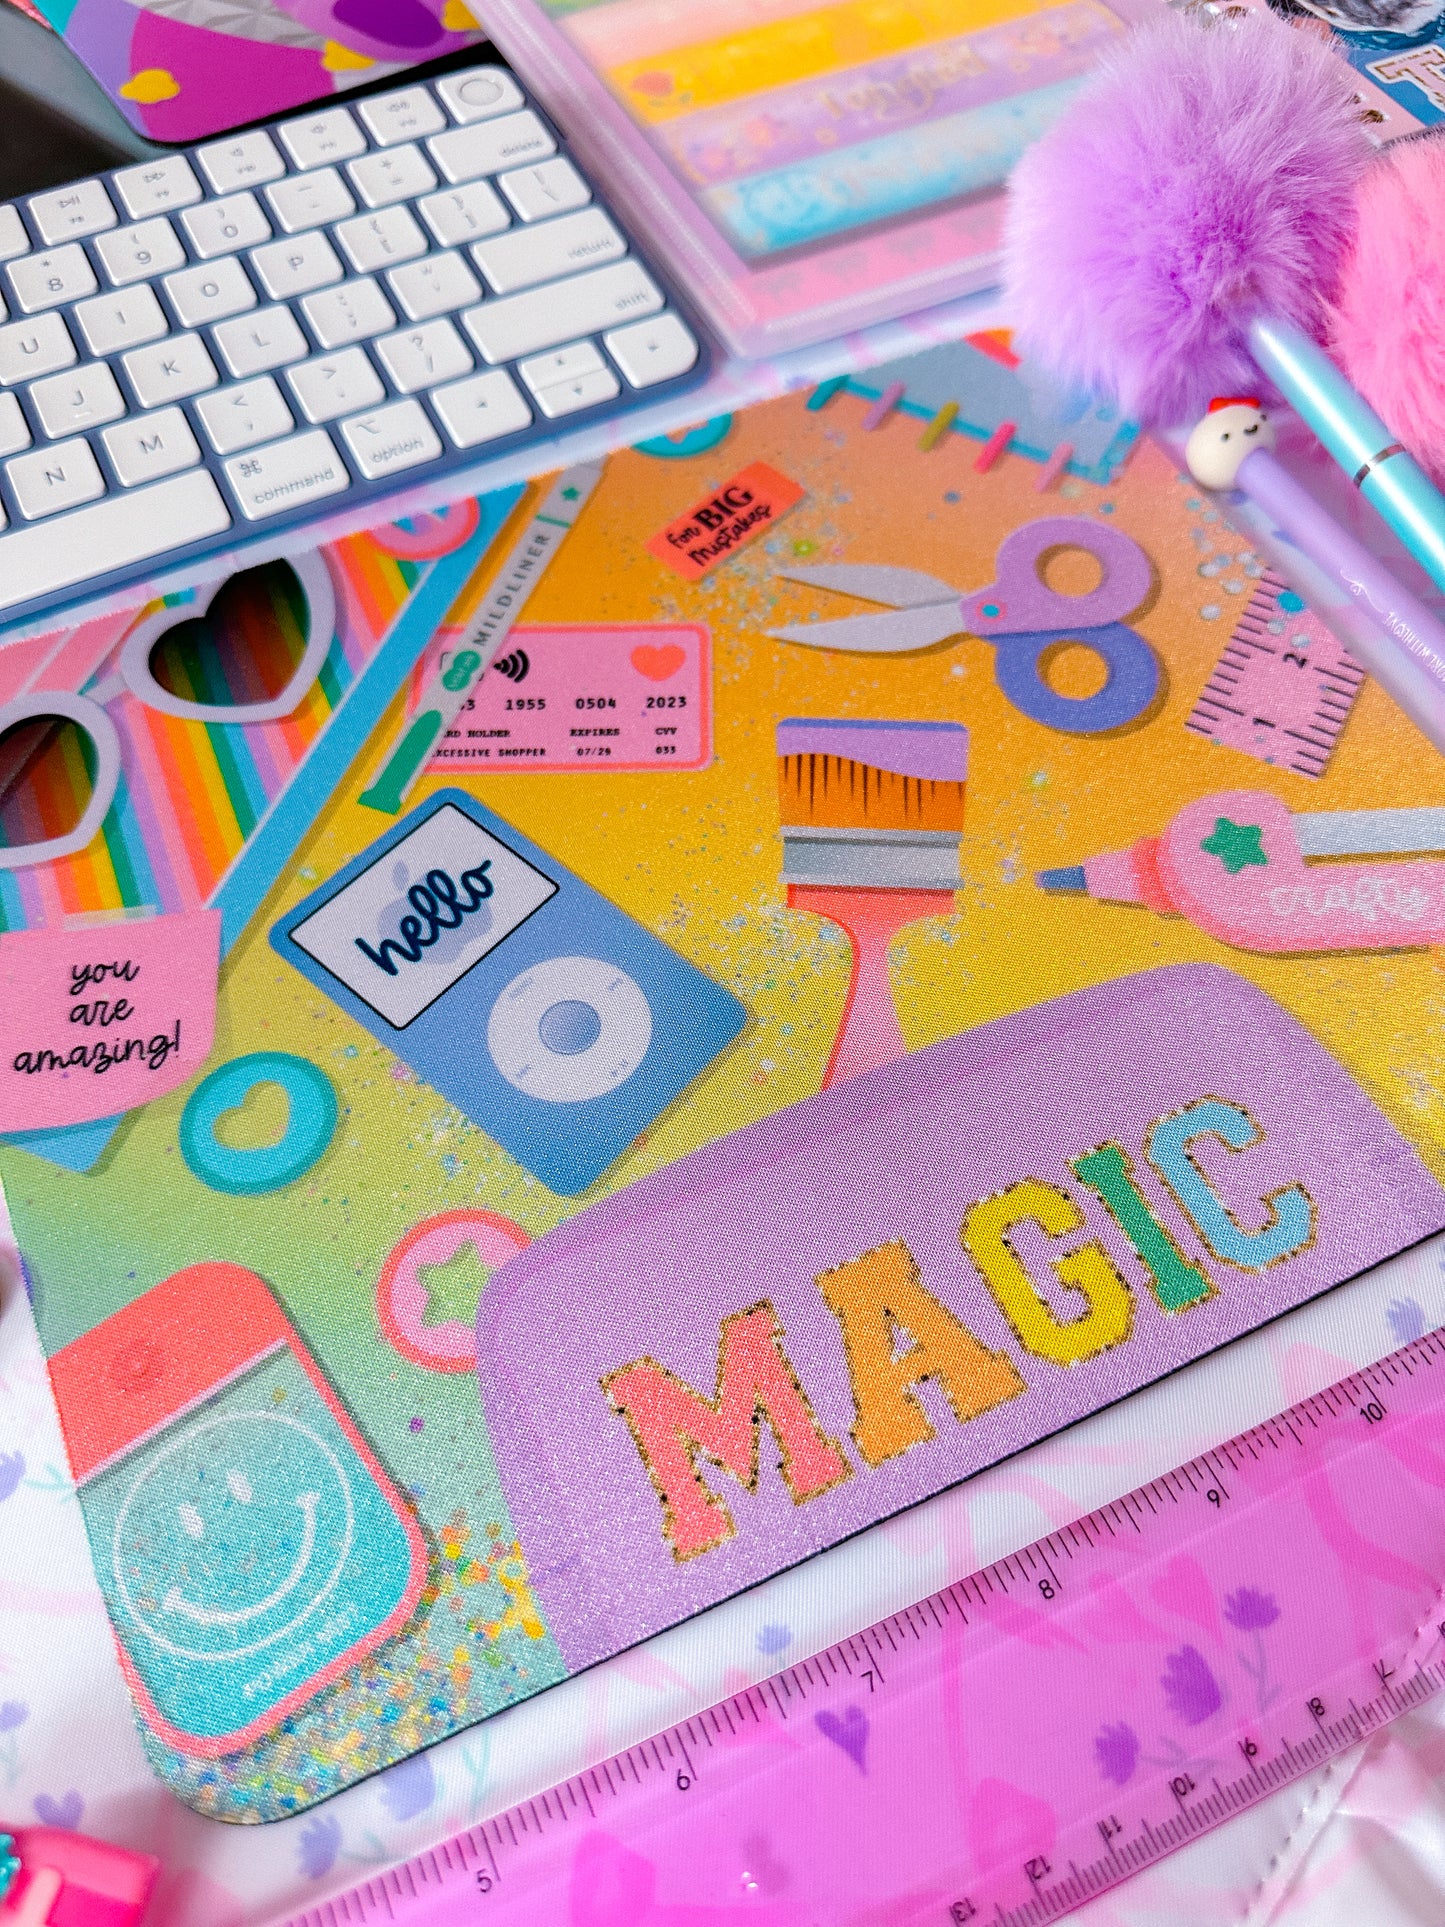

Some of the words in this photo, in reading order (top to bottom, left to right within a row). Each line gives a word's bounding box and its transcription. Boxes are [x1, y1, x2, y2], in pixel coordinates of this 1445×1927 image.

[135, 248, 153, 265] 9
[286, 254, 304, 272] P
[47, 277, 64, 293] 8
[20, 336, 40, 355] U
[250, 330, 271, 348] L
[161, 359, 182, 377] K
[69, 387, 85, 407] J
[138, 434, 165, 455] M
[369, 437, 425, 464] option
[43, 464, 68, 487] N
[254, 466, 336, 504] command
[692, 485, 754, 532] BIG
[472, 533, 551, 647] MILDLINER
[1282, 651, 1308, 669] 2
[505, 698, 546, 711] 1955
[575, 697, 617, 710] 0504
[645, 695, 687, 708] 2023
[443, 729, 462, 738] RD
[467, 729, 511, 738] HOLDER
[569, 727, 620, 737] EXPIRES
[654, 726, 678, 736] CVV
[1252, 716, 1277, 729] 1
[432, 748, 491, 758] XCESSIVE
[498, 747, 547, 757] SHOPPER
[353, 858, 493, 977] hello
[68, 959, 141, 996] you
[68, 997, 136, 1028] are
[13, 1018, 181, 1074] amazing!
[598, 1094, 1319, 1565] MAGIC
[476, 1868, 493, 1894] 5
[675, 1767, 691, 1792] 6
[860, 1669, 875, 1693] 7
[1037, 1578, 1056, 1600] 8
[1206, 1488, 1221, 1509] 9
[1359, 1401, 1384, 1425] 10
[1379, 1659, 1395, 1679] 7
[1310, 1696, 1326, 1717] 8
[1173, 1772, 1196, 1796] 10
[1025, 1854, 1052, 1881] 12
[951, 1896, 977, 1923] 13
